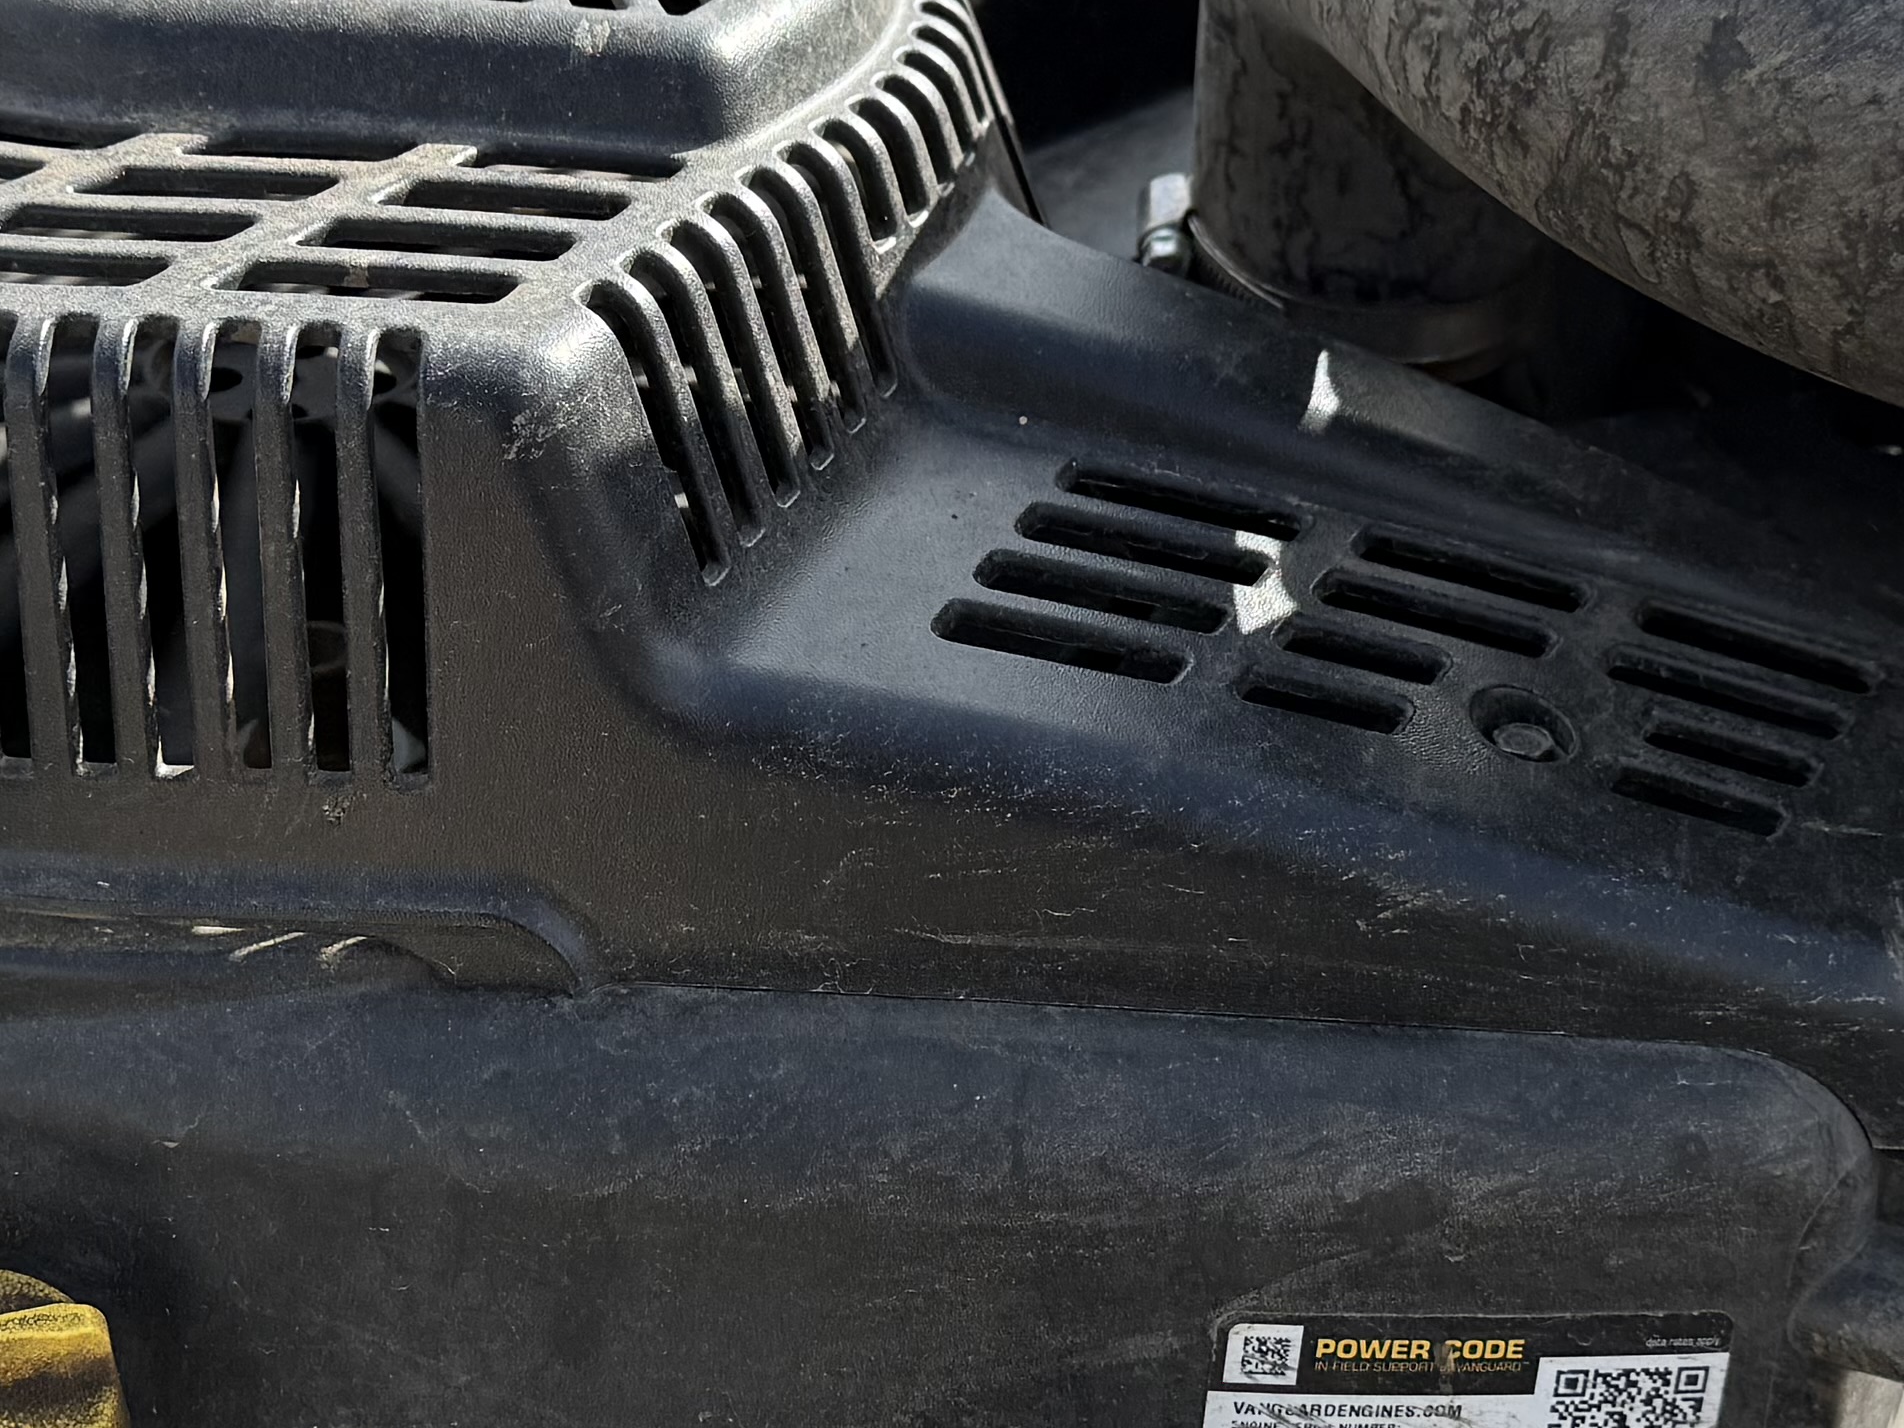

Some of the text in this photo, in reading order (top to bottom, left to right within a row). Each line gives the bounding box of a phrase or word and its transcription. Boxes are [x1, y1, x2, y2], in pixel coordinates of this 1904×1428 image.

[1315, 1338, 1526, 1360] POWER CODE
[1374, 1362, 1434, 1373] SUPPORT
[1233, 1400, 1463, 1419] VANGUARDENGINES.COM
